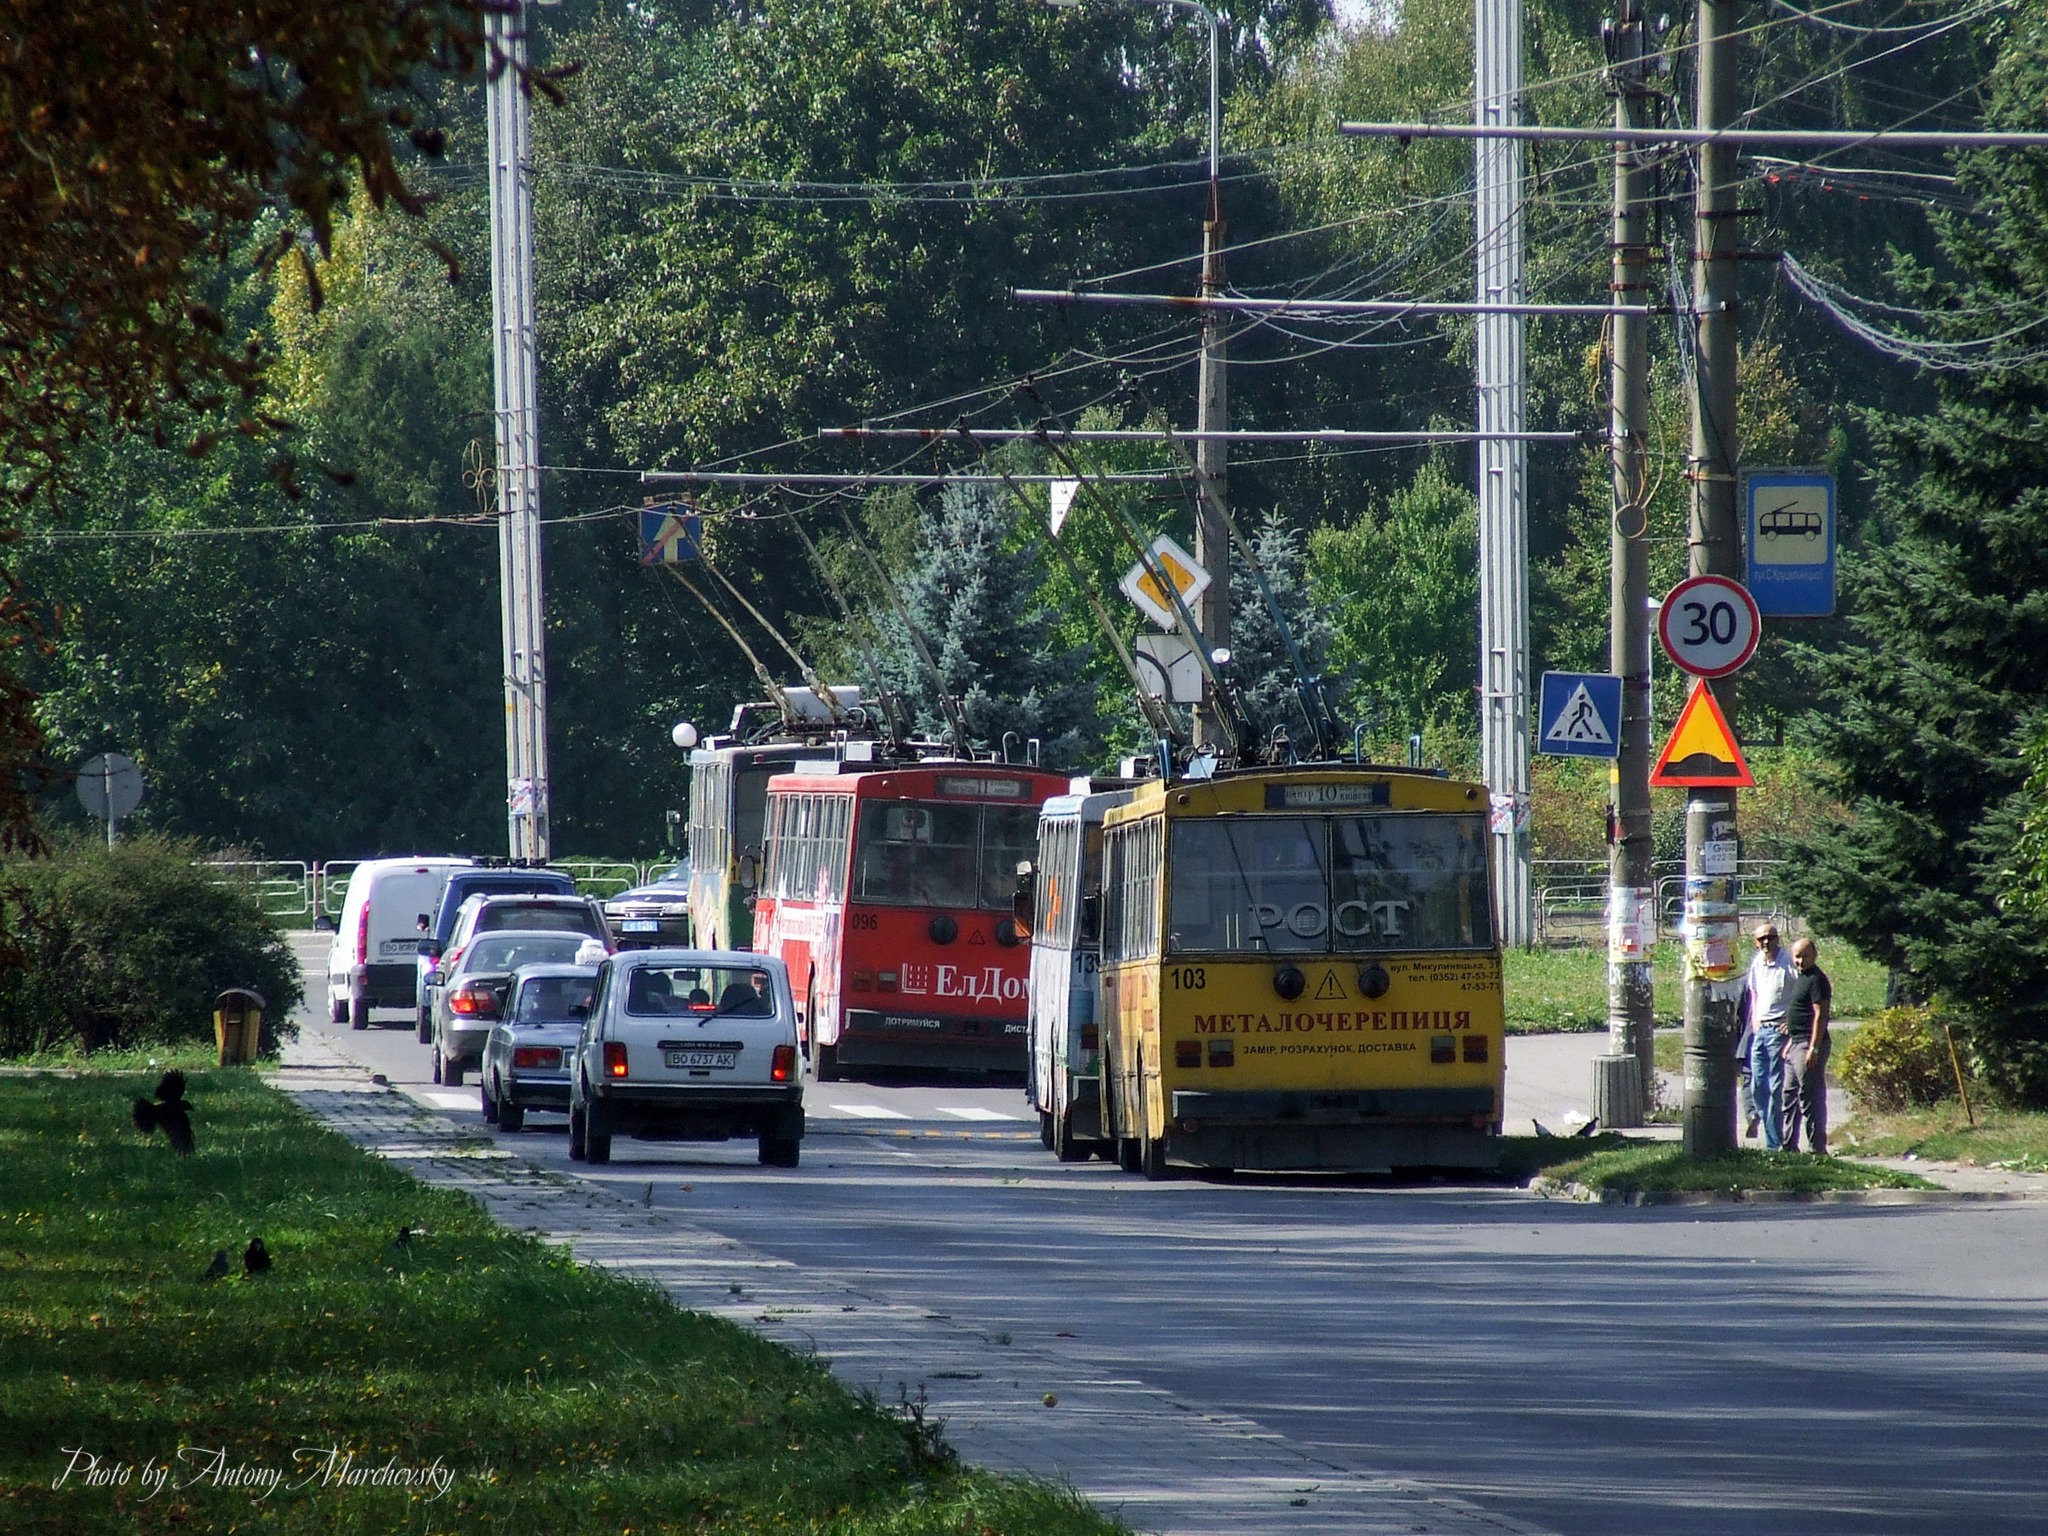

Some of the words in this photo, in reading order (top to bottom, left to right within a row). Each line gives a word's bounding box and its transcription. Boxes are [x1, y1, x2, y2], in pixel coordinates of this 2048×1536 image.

[1683, 601, 1737, 646] 30
[1316, 784, 1338, 802] 10
[851, 912, 878, 932] 096
[1247, 900, 1410, 939] РОСТ
[1171, 968, 1206, 990] 103
[1429, 973, 1459, 982] (0352)
[884, 1016, 941, 1029] ДОТРИМУЙСЯ
[1193, 1010, 1471, 1035] МЕТАЛОЧЕРЕПИЦЯ
[1243, 1045, 1278, 1055] ЗАМІР,
[1280, 1044, 1355, 1055] РОЗРАХУНОК,
[1357, 1043, 1417, 1053] ДОСТАВКА
[672, 1053, 688, 1064] BO
[690, 1053, 714, 1065] 6737
[716, 1054, 732, 1065] AK
